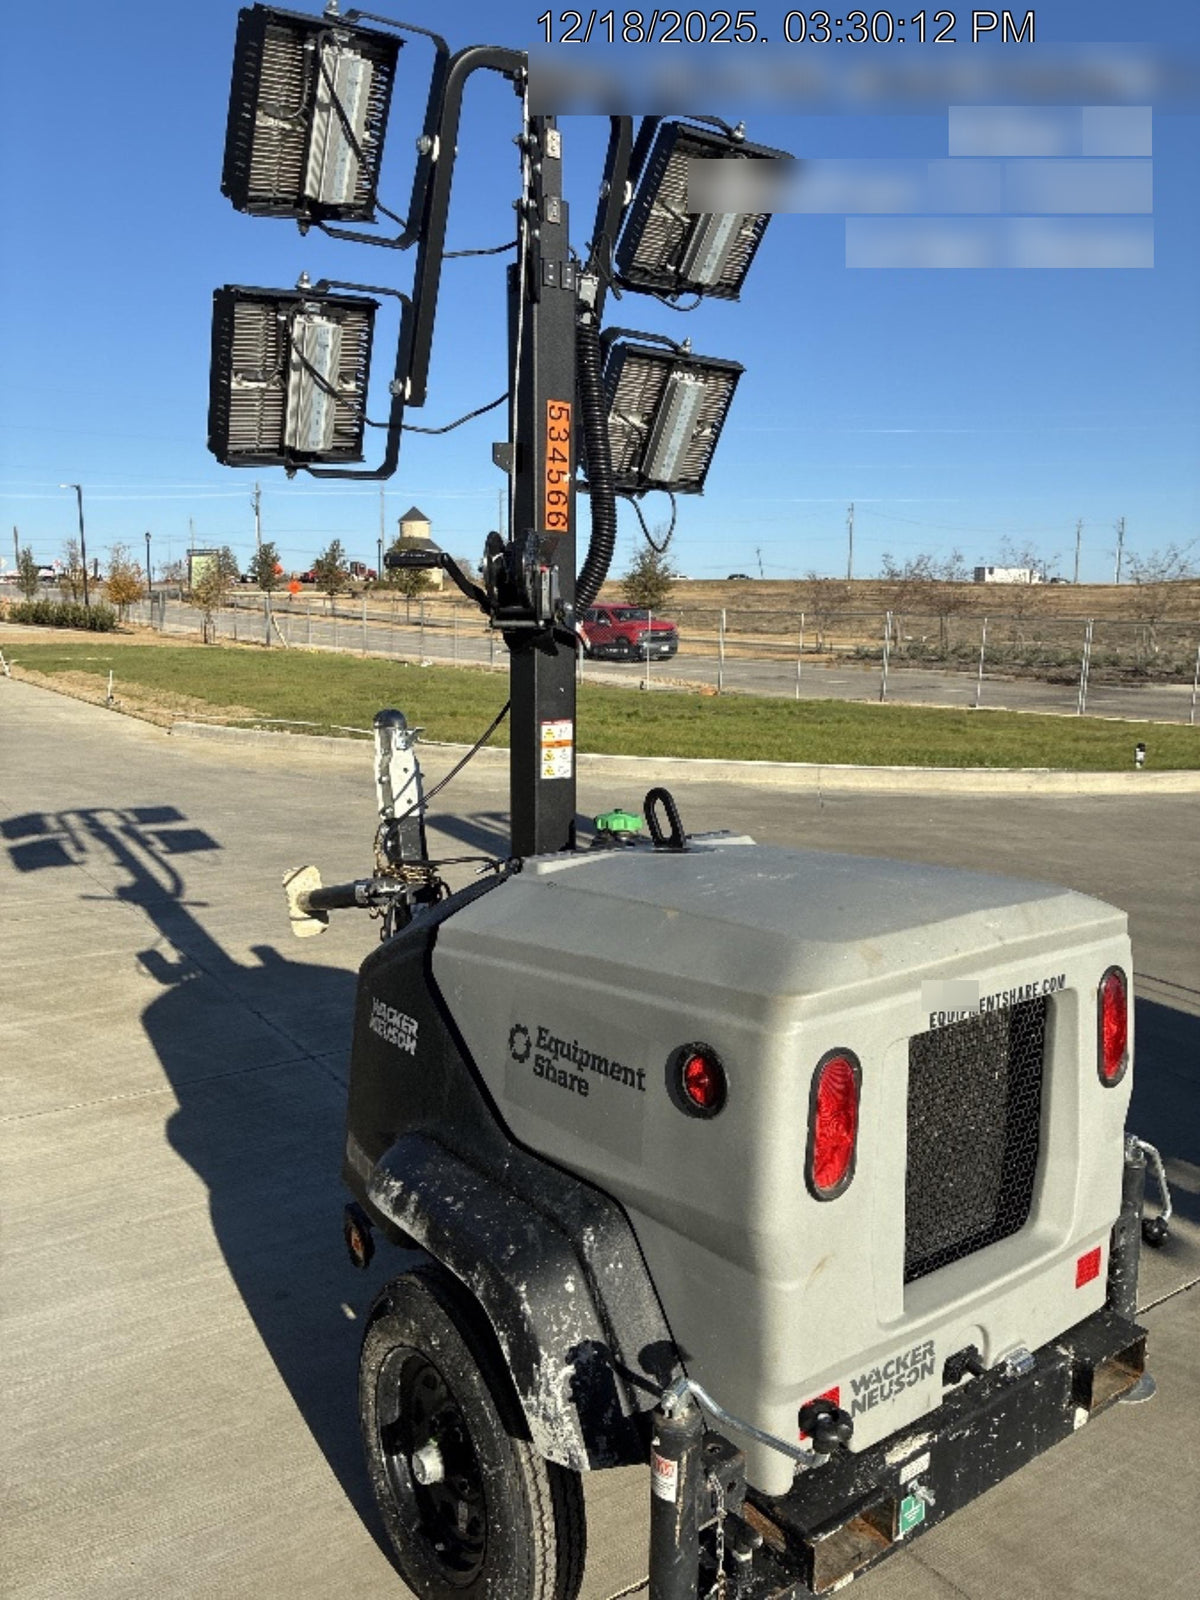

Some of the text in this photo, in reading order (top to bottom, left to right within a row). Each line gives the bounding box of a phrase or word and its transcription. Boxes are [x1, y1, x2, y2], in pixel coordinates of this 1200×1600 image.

[547, 402, 570, 529] 534566
[533, 1054, 590, 1097] Share
[535, 1025, 646, 1091] Equipment
[849, 1339, 936, 1396] WACKER
[850, 1357, 935, 1418] NEUSON
